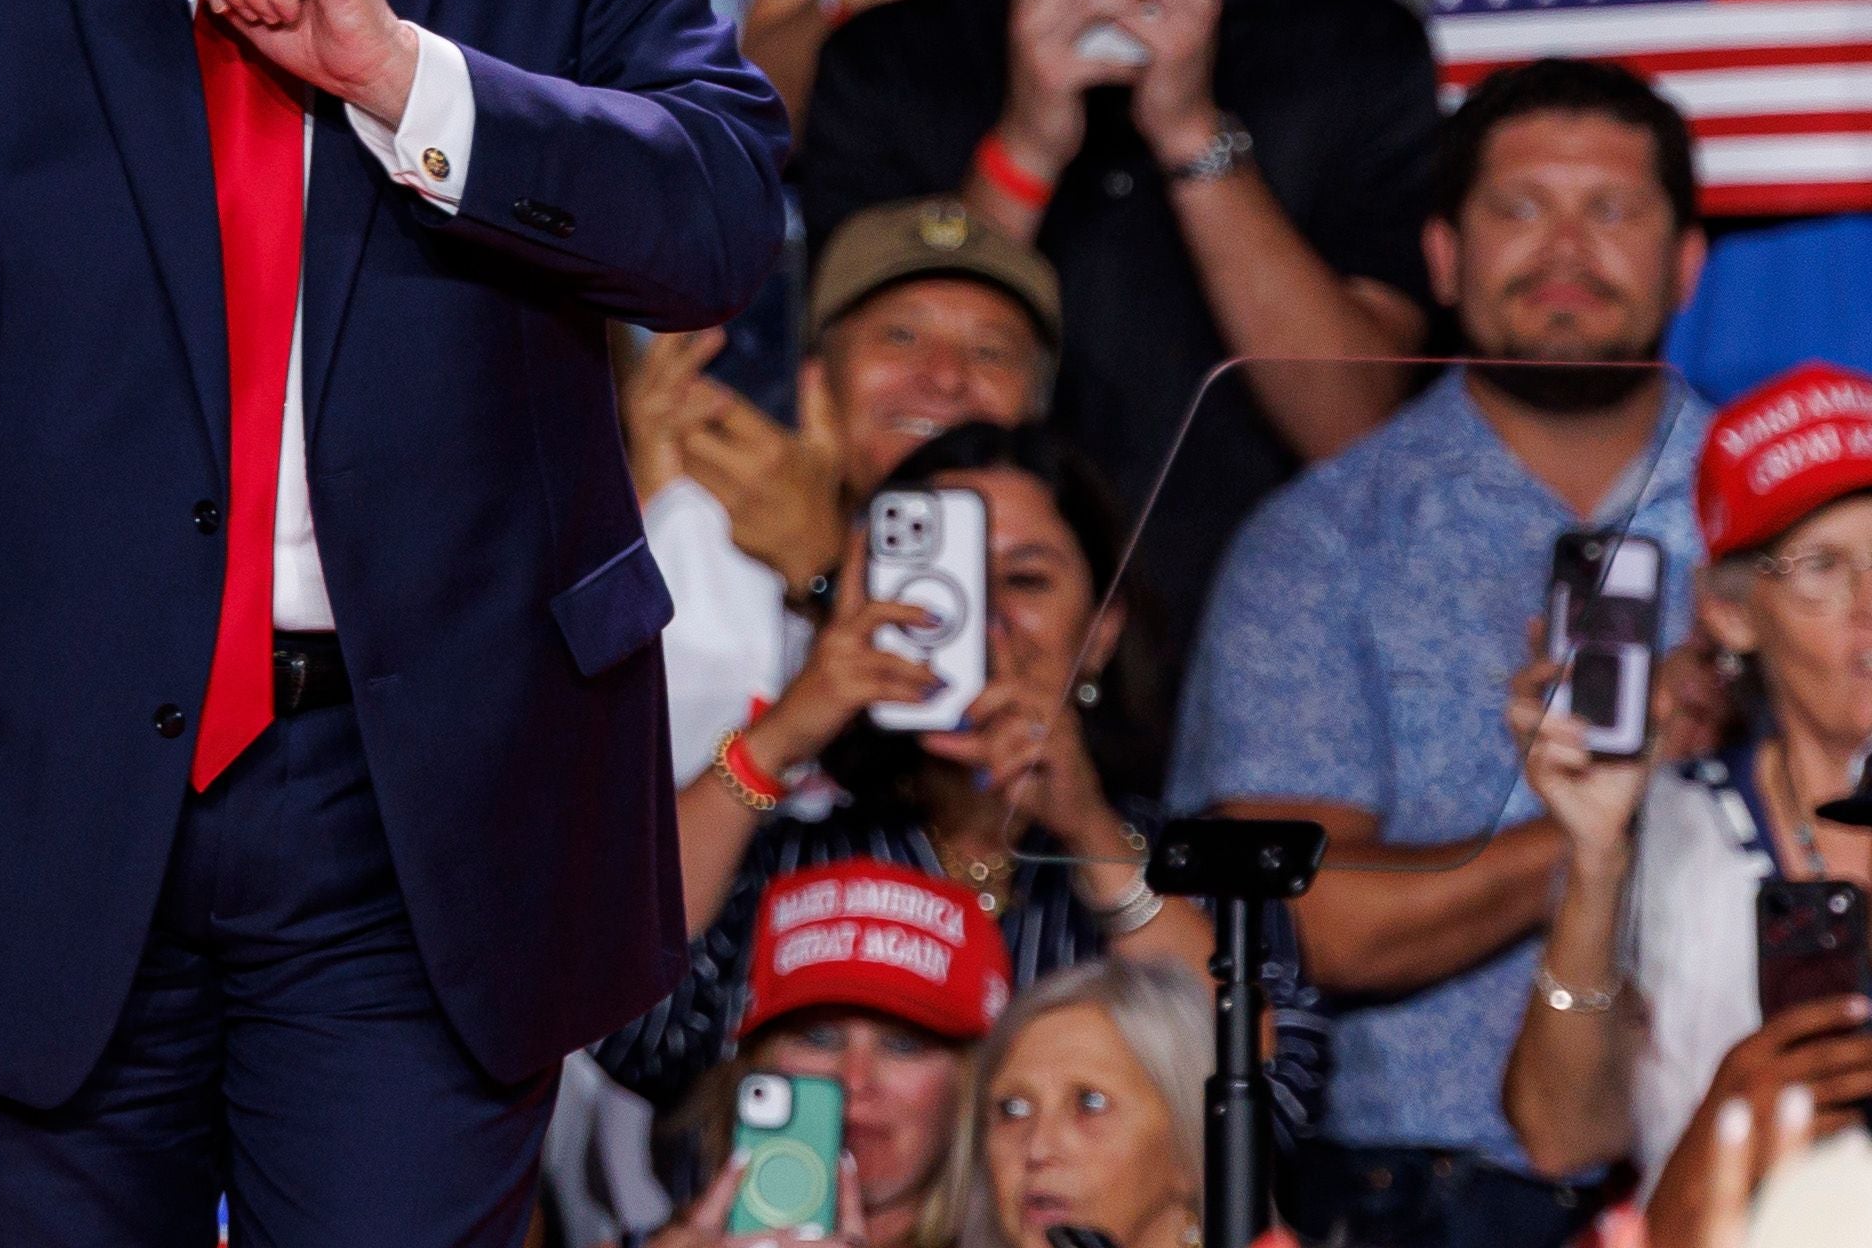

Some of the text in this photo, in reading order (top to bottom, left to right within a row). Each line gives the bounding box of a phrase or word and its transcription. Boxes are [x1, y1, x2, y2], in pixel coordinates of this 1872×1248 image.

[1717, 391, 1802, 458] MAKE
[1748, 424, 1842, 495] GREAT
[773, 877, 966, 948] MAKE AMERICA
[773, 920, 953, 986] GREAT AGAIN
